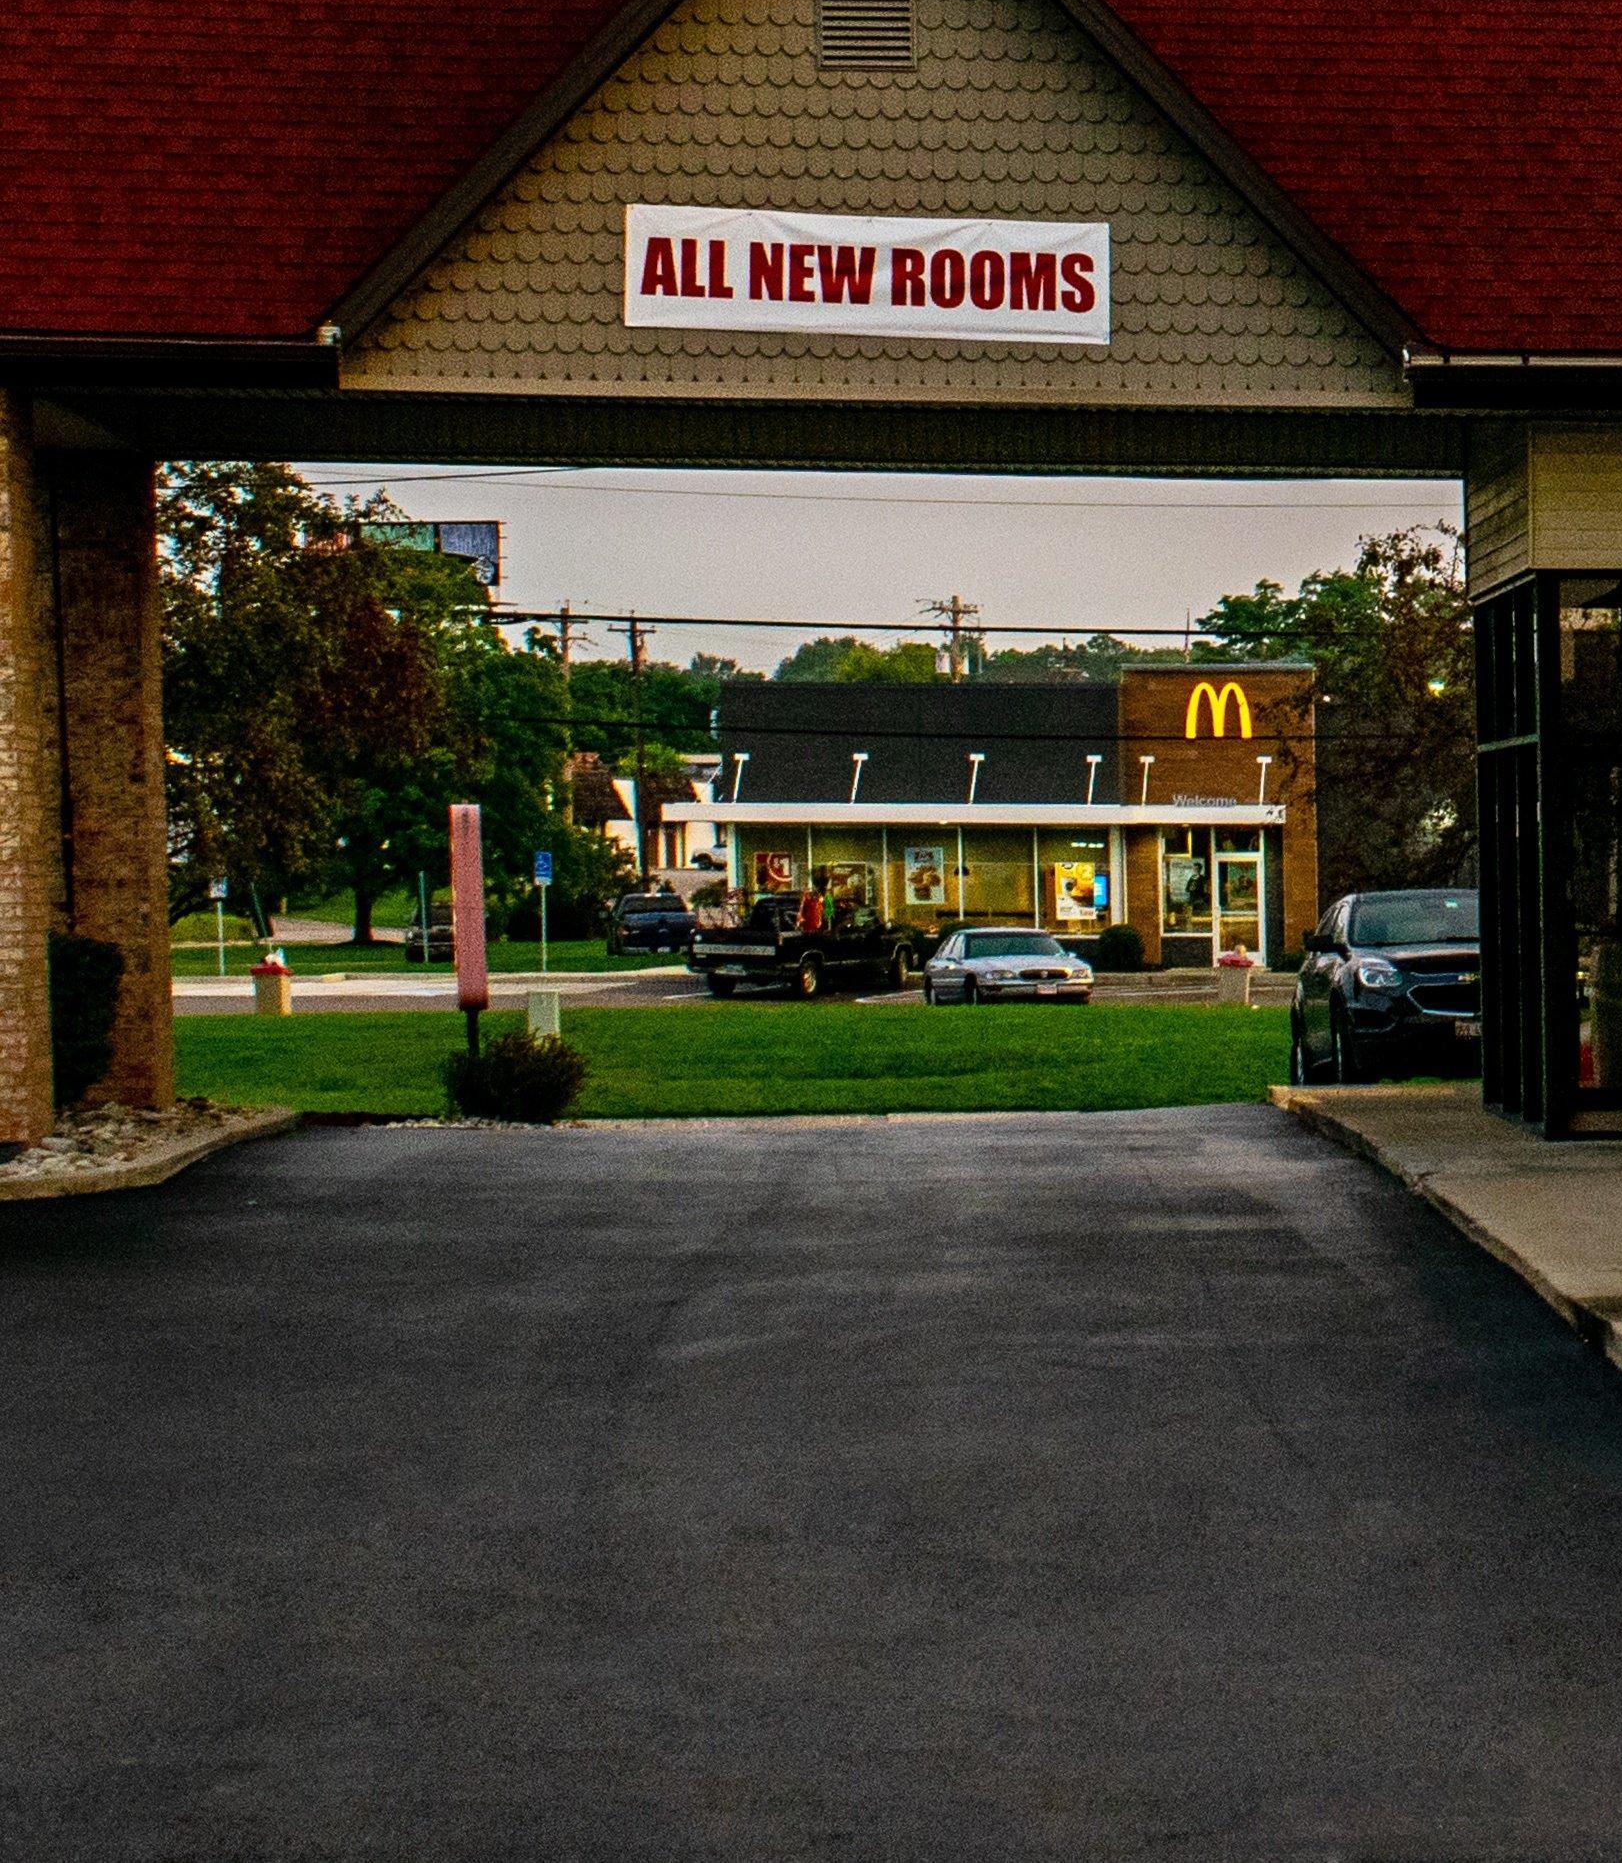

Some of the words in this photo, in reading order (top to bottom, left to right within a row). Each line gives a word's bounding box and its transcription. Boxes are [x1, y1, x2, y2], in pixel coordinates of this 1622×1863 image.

[640, 236, 734, 300] ALL
[748, 241, 876, 305] NEW
[890, 247, 1096, 314] ROOMS
[1173, 794, 1237, 808] Welcome
